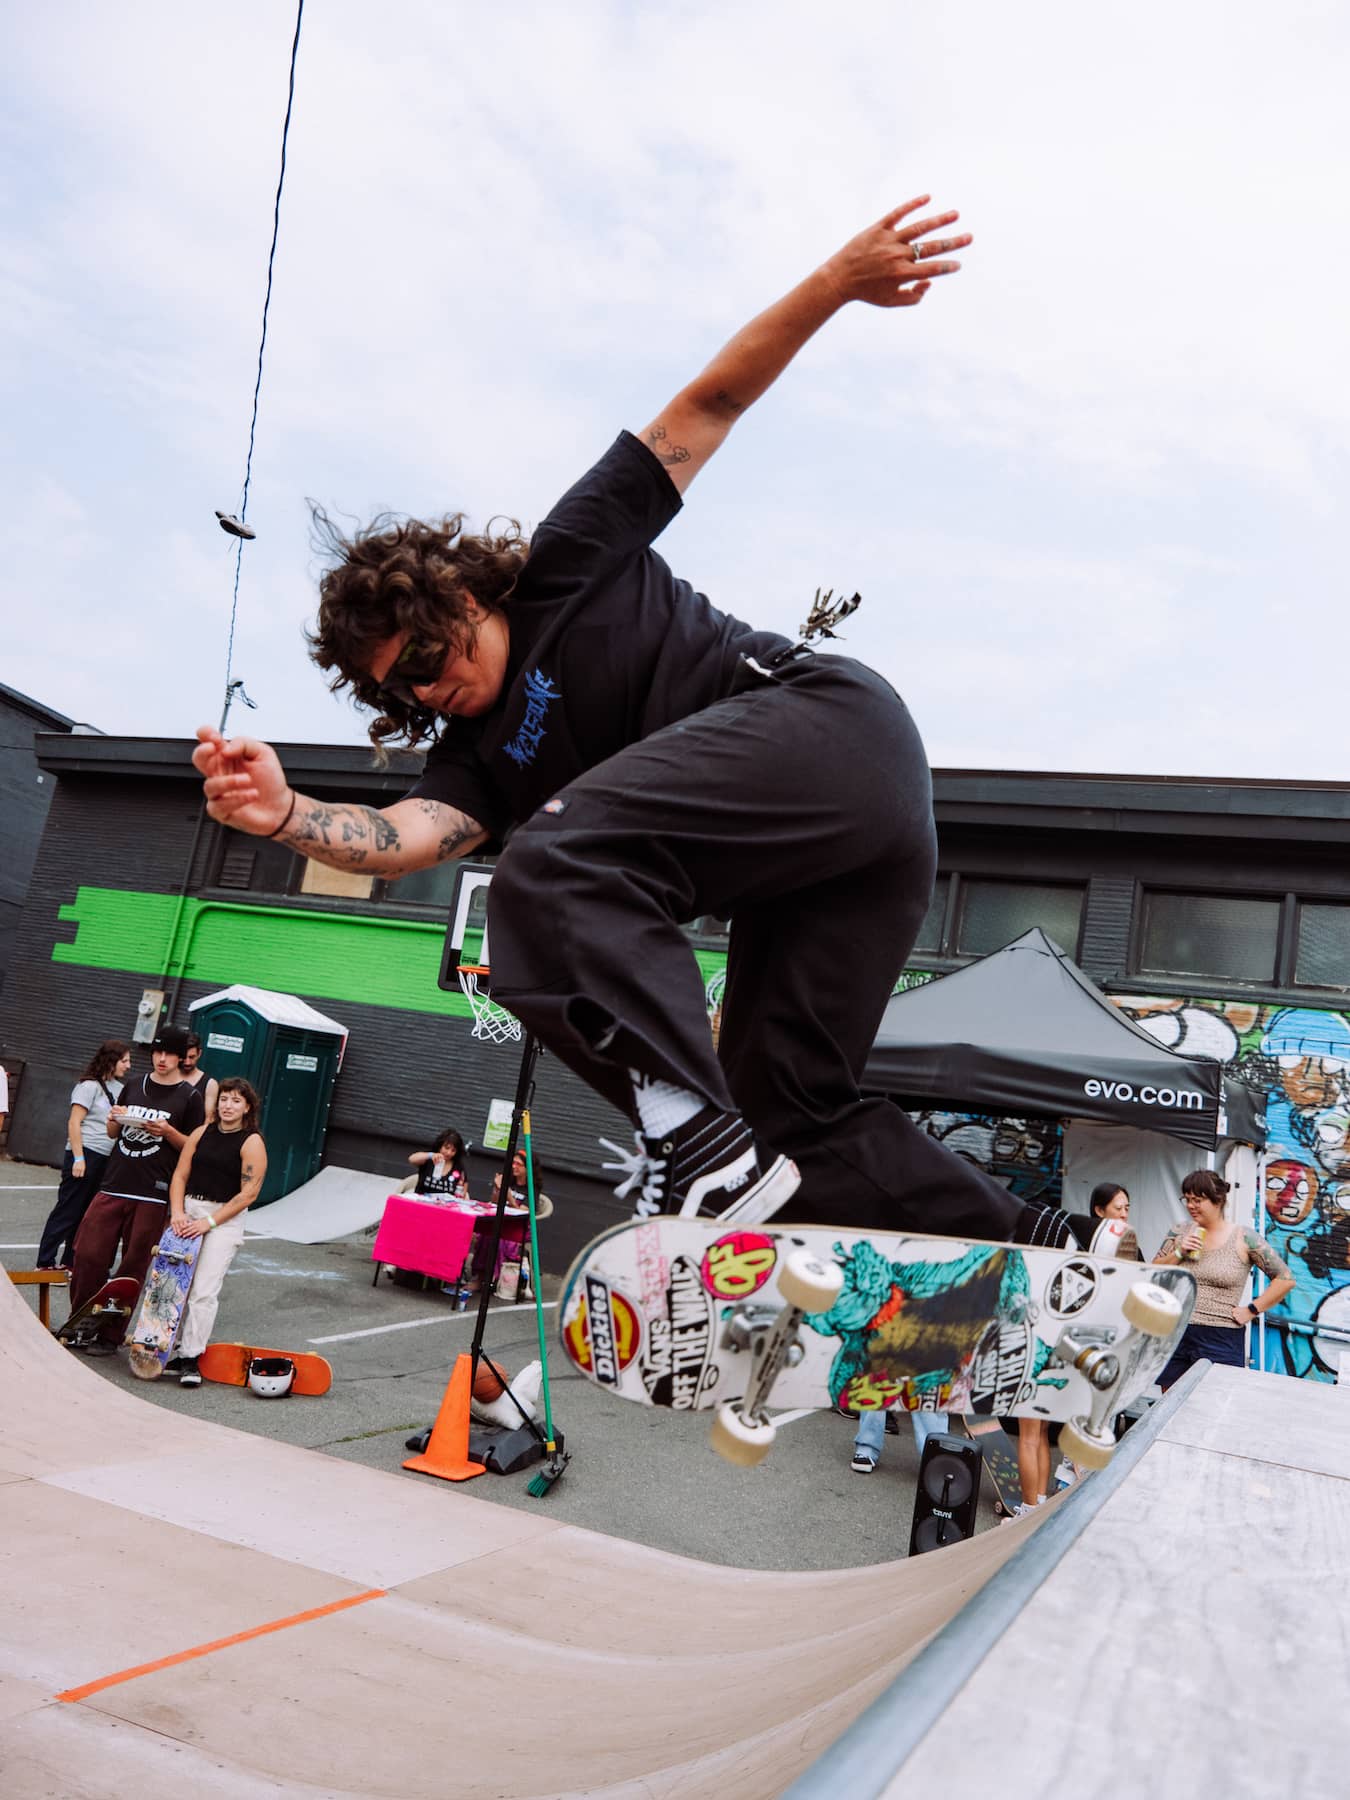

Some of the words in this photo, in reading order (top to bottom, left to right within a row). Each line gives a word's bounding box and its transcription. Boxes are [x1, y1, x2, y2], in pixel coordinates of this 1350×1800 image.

[1084, 1079, 1203, 1110] evo.com
[672, 1266, 708, 1328] WALL
[673, 1324, 709, 1374] THE
[996, 1349, 1026, 1392] THE
[672, 1374, 698, 1410] OFF
